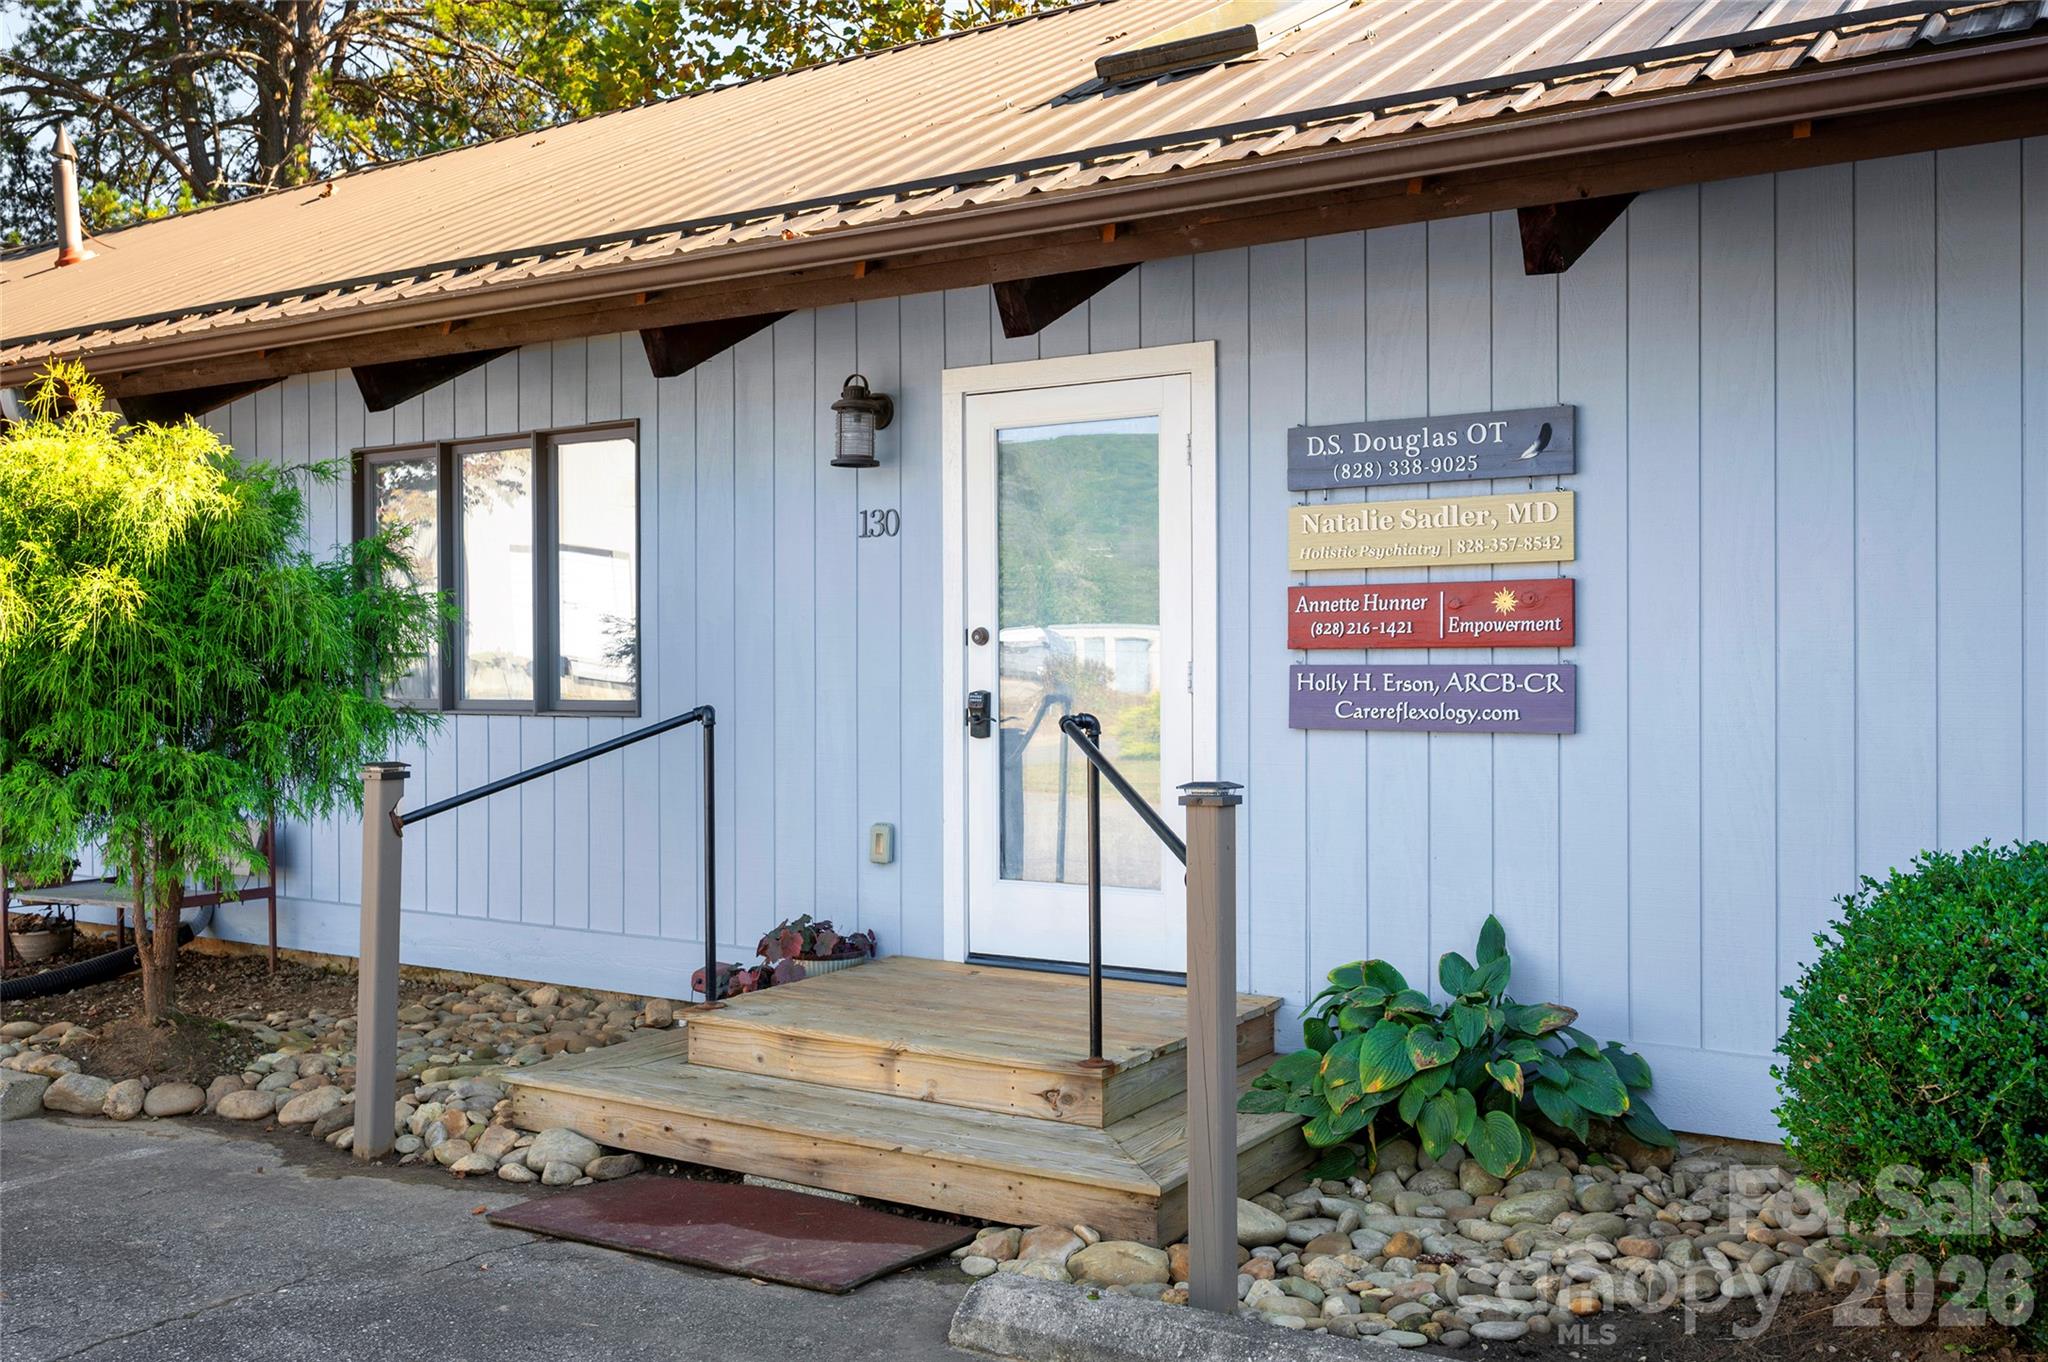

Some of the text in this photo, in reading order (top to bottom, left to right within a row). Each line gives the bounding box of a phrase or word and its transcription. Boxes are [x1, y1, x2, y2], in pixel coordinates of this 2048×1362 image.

[1307, 421, 1508, 457] D.S. Douglas OT
[1333, 454, 1479, 482] (828) 338-9025
[858, 509, 900, 538] 130
[1300, 500, 1558, 536] Natalie Sadler, MD
[1299, 535, 1562, 561] Holistic Psychiatry 828-357-8542
[1295, 593, 1428, 613] Annette Hunner
[1310, 621, 1413, 638] (828) 216-1421
[1448, 616, 1562, 638] Empowerment
[1296, 672, 1564, 696] Holly H. Erson, ARCB-CR
[1334, 700, 1521, 725] Carereflexology.com
